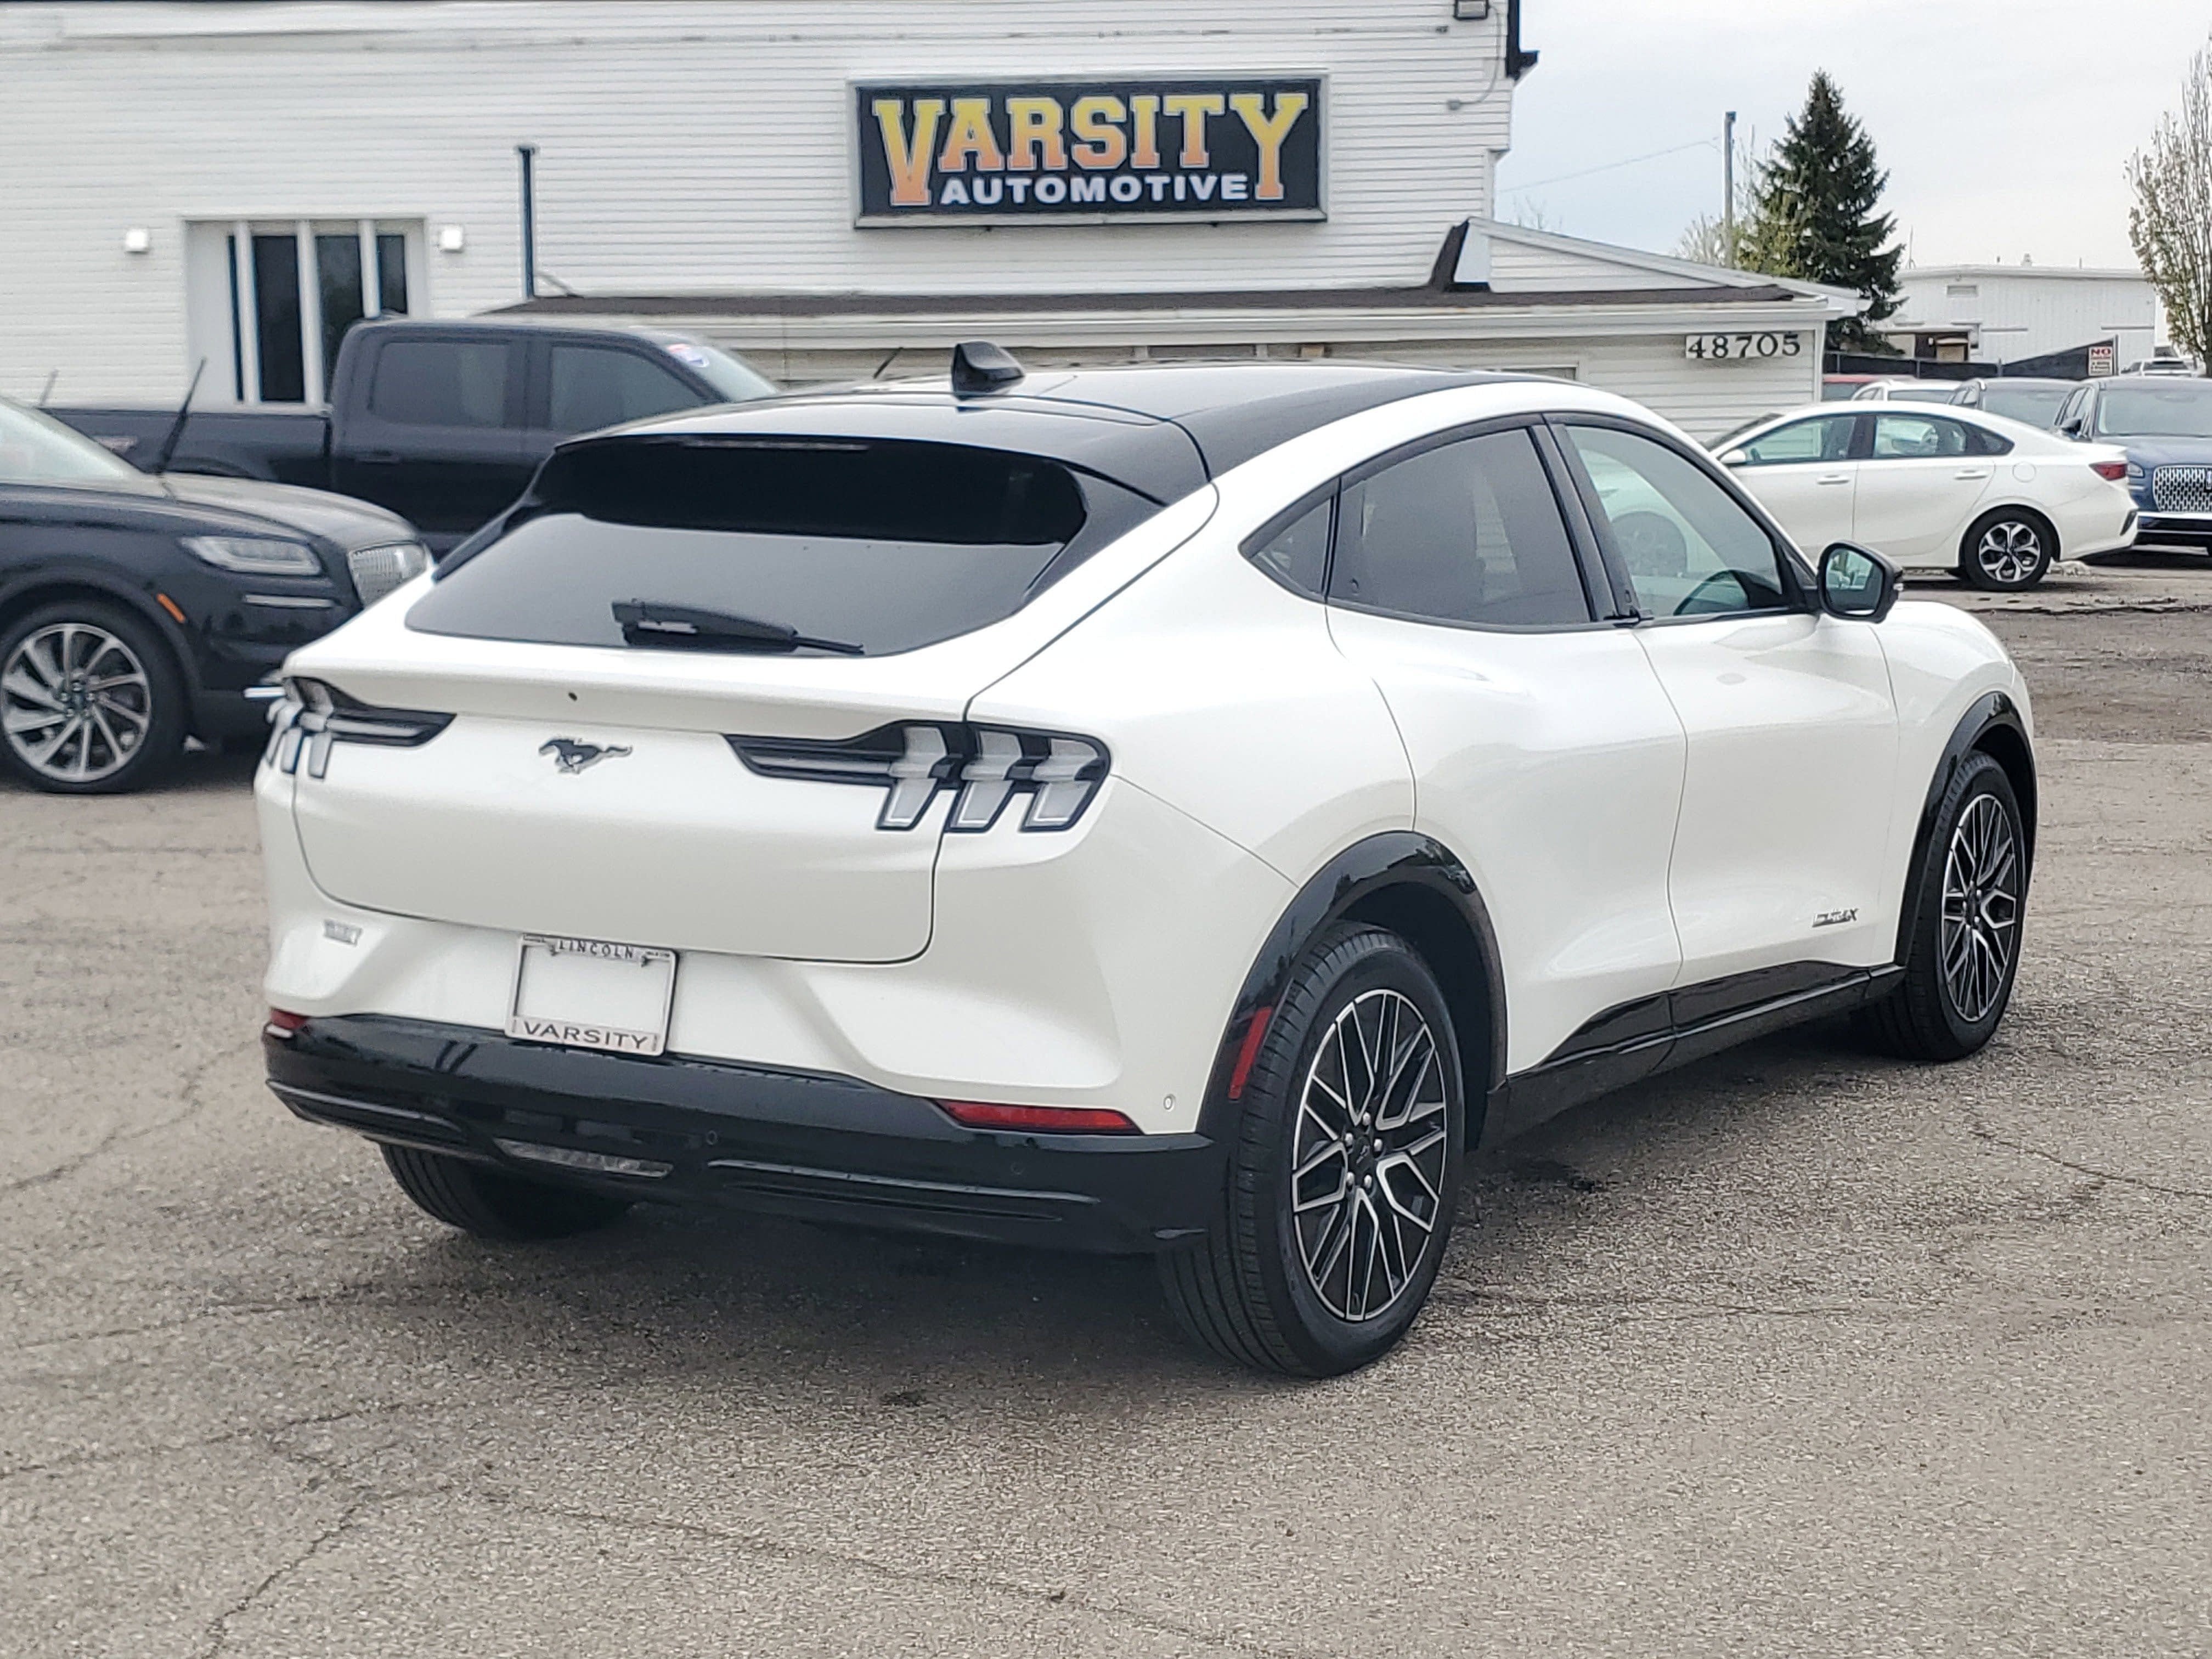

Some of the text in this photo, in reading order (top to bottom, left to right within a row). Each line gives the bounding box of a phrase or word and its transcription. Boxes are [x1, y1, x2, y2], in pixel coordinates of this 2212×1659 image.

[872, 93, 1309, 206] VARSITY
[940, 173, 1248, 205] AUTOMOTIVE
[1688, 332, 1801, 358] 48705
[558, 939, 634, 958] LINCOLN
[523, 1021, 647, 1049] VARSITY
